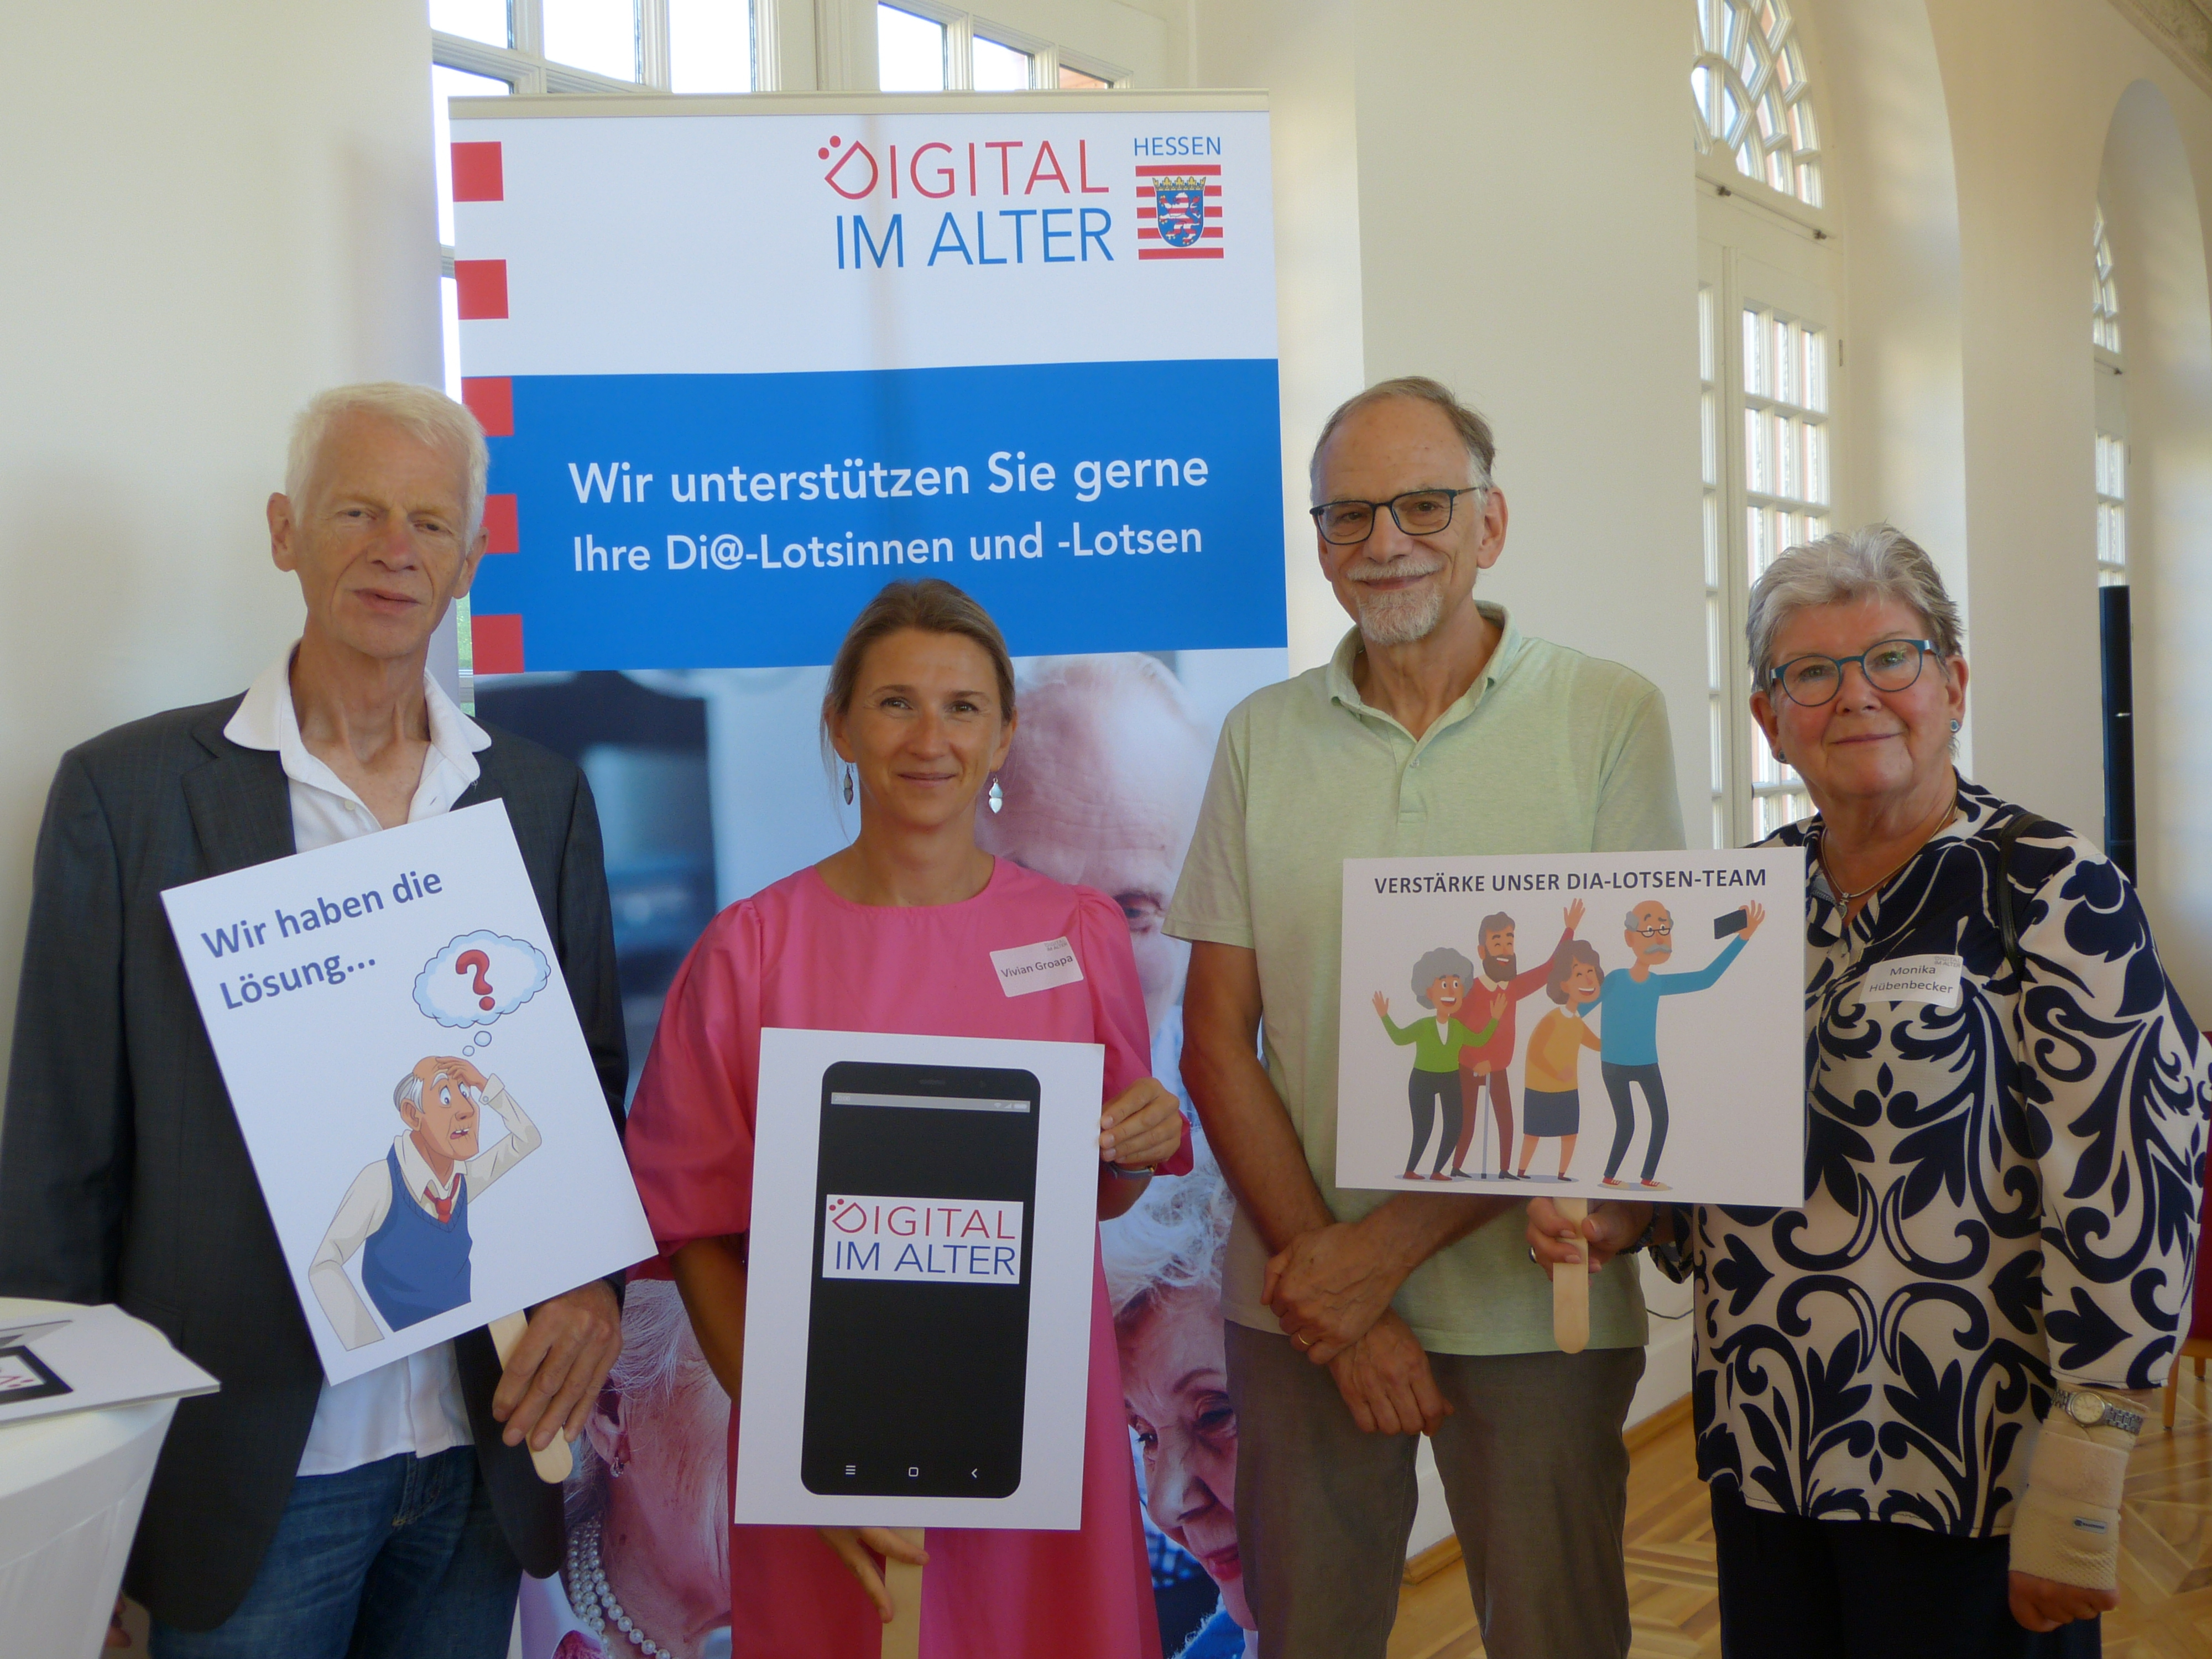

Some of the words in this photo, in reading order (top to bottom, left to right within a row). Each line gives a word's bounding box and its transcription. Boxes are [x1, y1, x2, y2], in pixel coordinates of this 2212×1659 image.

[1134, 136, 1222, 156] HESSEN
[818, 135, 1109, 200] DIGITAL
[836, 213, 904, 270] IM
[927, 207, 1115, 267] ALTER
[568, 461, 654, 504] Wir
[672, 457, 971, 503] unterstützen
[987, 451, 1056, 493] Sie
[1074, 457, 1210, 502] gerne
[574, 534, 651, 572] Ihre
[667, 531, 954, 571] Di@-Lotsinnen
[971, 521, 1044, 562] und
[1058, 520, 1203, 557] -Lotsen
[1374, 872, 1486, 894] VERSTÄRKE
[1492, 873, 1561, 892] UNSER
[1567, 868, 1767, 890] DIA-LOTSEN-TEAM
[200, 920, 267, 958] Wir
[274, 890, 384, 938] haben
[392, 870, 443, 904] die
[220, 955, 376, 1010] Lösung...
[1000, 964, 1034, 978] Vivian
[1035, 955, 1073, 971] Groapa
[1869, 980, 1953, 993] Hübenbecker
[1890, 965, 1936, 976] Monika
[829, 1198, 1016, 1240] DIGITAL
[836, 1240, 880, 1271] IM
[894, 1243, 1015, 1276] ALTER
